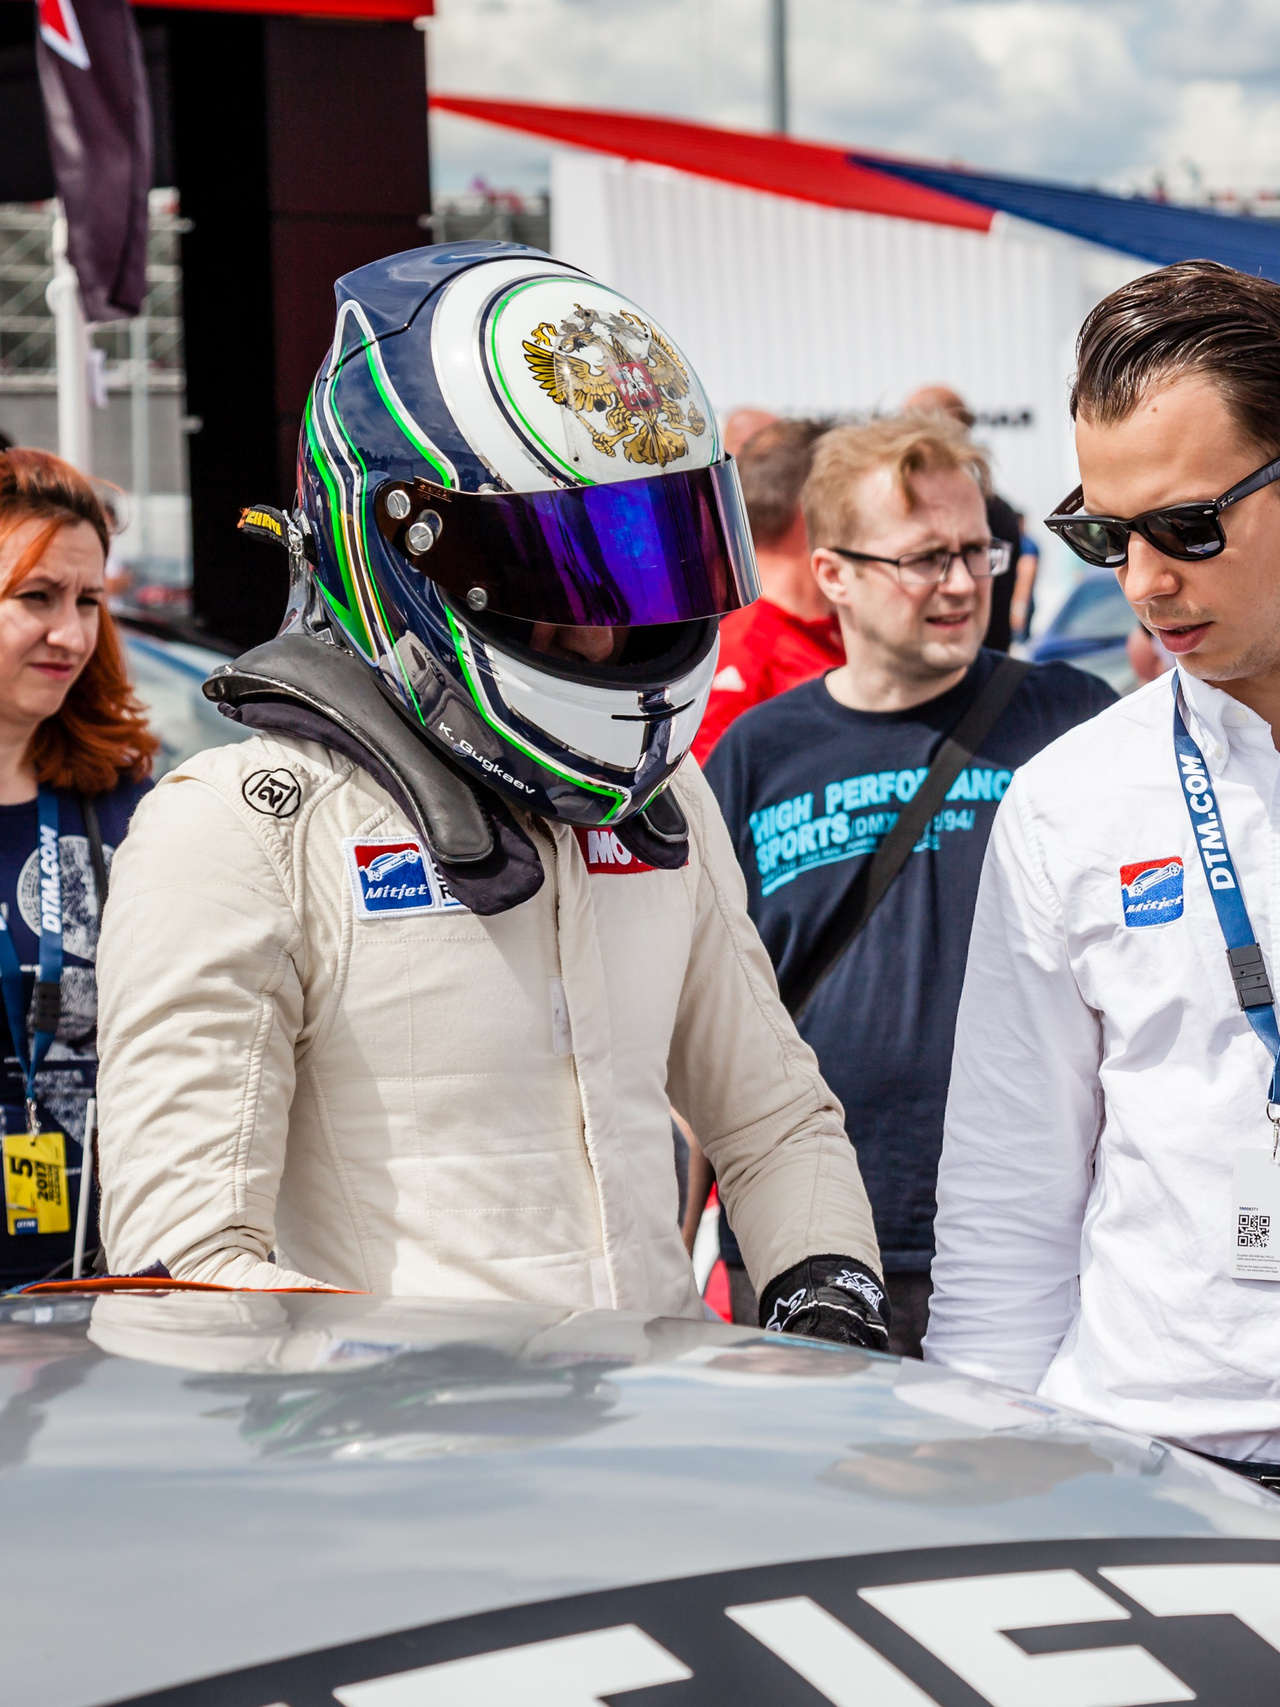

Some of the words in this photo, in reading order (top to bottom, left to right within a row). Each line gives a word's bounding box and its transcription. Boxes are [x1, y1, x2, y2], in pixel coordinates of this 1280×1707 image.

[438, 721, 455, 741] K.
[459, 739, 536, 794] Gugkaev
[257, 777, 291, 809] 21
[748, 791, 814, 845] HIGH
[824, 766, 1015, 815] PERFOANC
[1179, 753, 1236, 890] DTM.COM
[587, 830, 642, 865] MO
[755, 811, 850, 875] SPORTS
[39, 823, 62, 935] DTM.COM
[365, 883, 430, 900] Mitjet
[1125, 894, 1184, 914] Mitjet
[10, 1156, 33, 1179] 5
[35, 1160, 49, 1202] 2017
